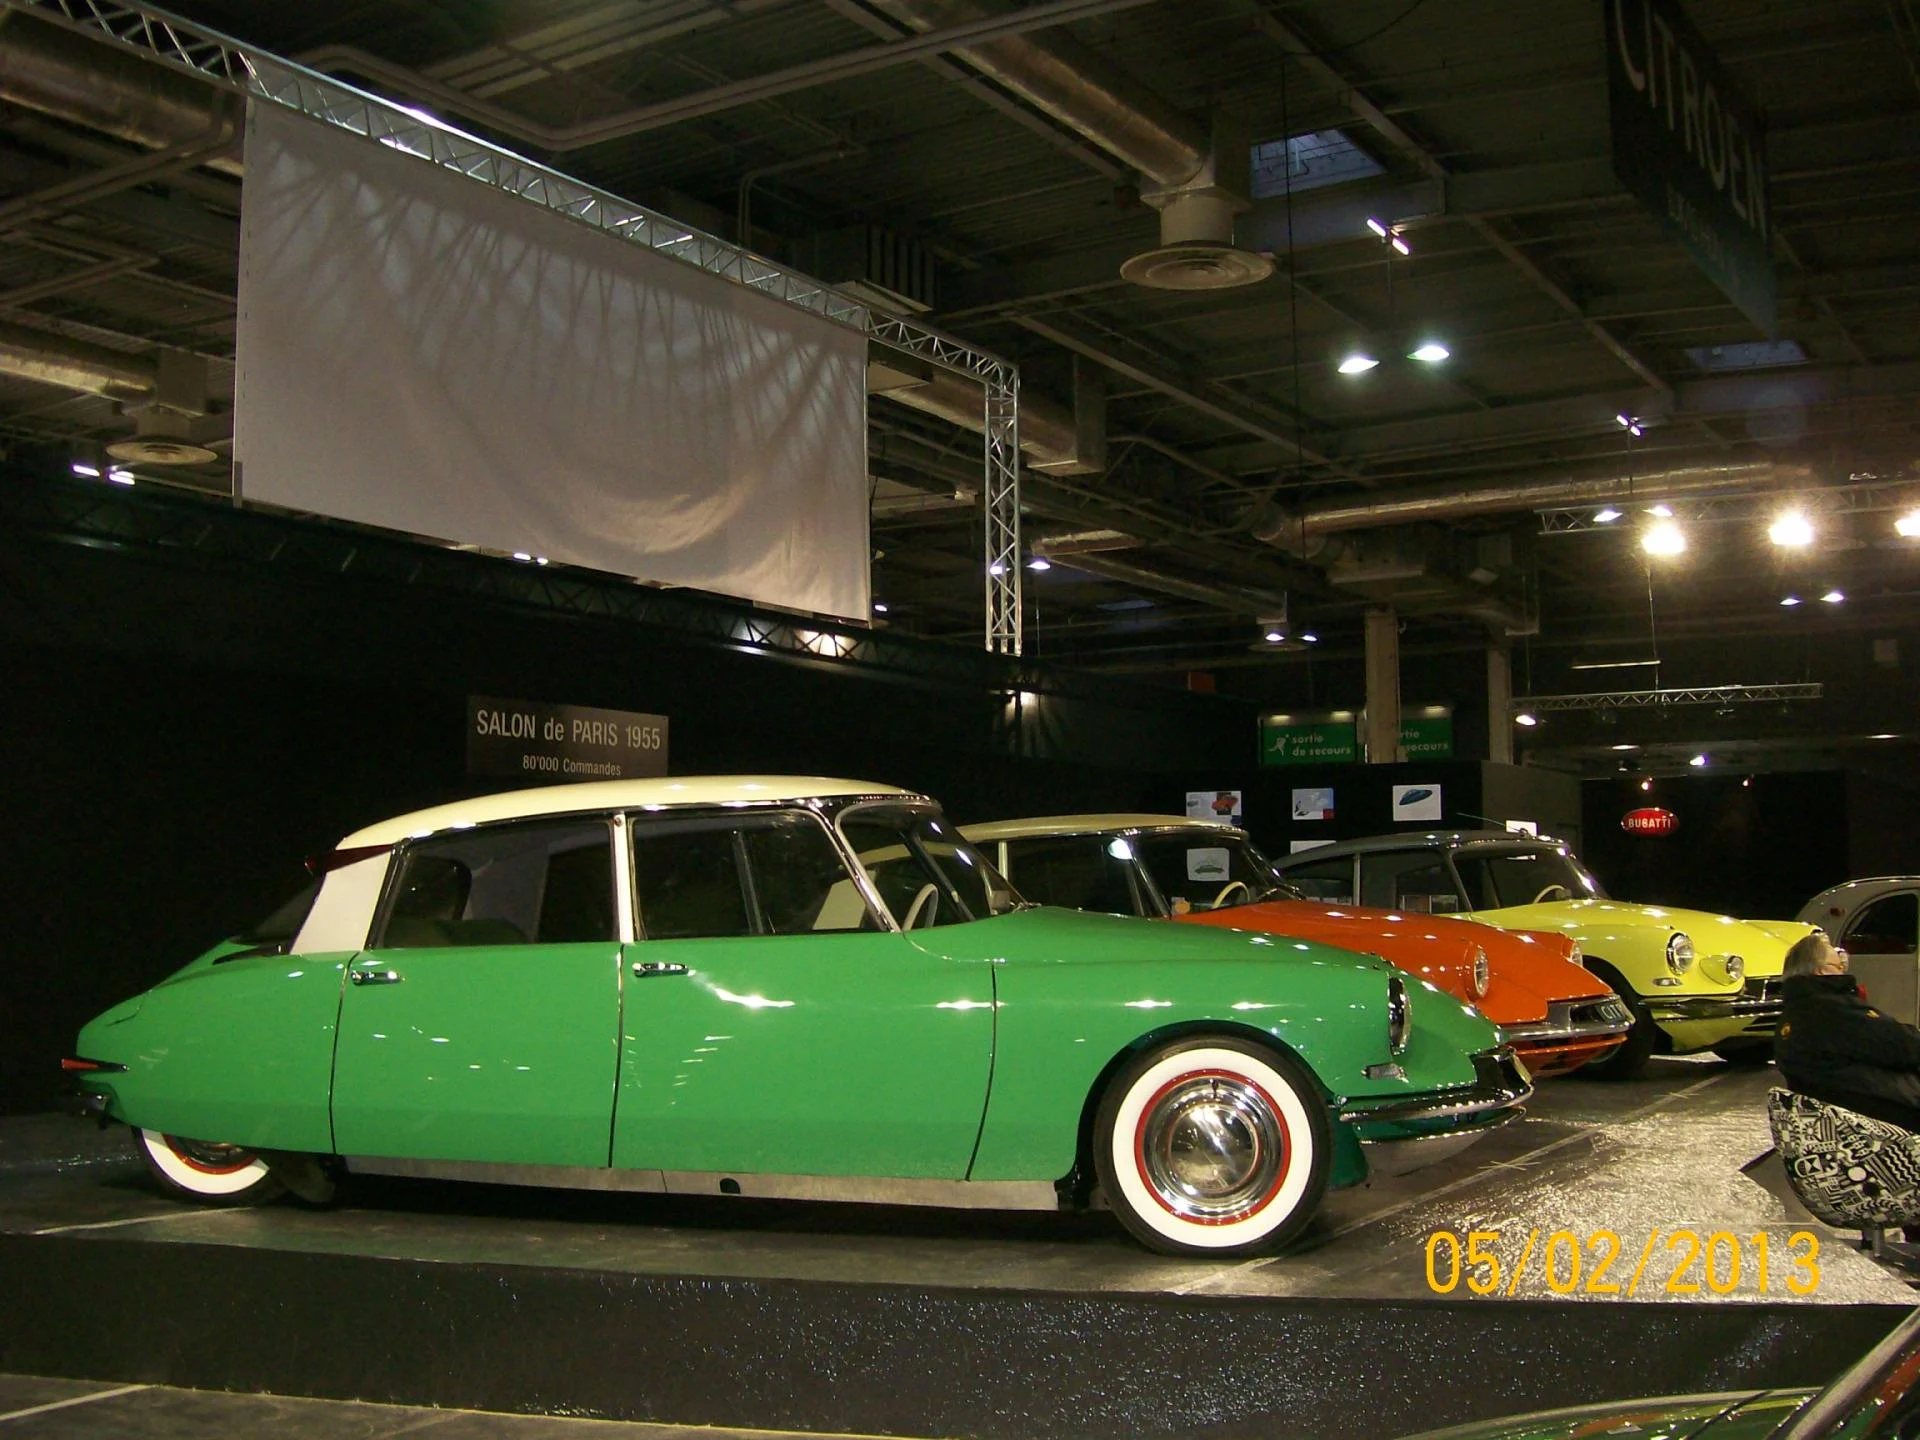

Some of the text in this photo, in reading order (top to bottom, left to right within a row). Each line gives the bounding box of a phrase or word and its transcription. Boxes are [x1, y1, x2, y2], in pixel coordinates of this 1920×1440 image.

[476, 709, 661, 750] SALON de PARIS 1955
[1292, 734, 1324, 744] sortie
[1292, 746, 1351, 757] de secours
[522, 755, 621, 776] 80'000 Commandes
[1628, 818, 1671, 829] BUGATTI
